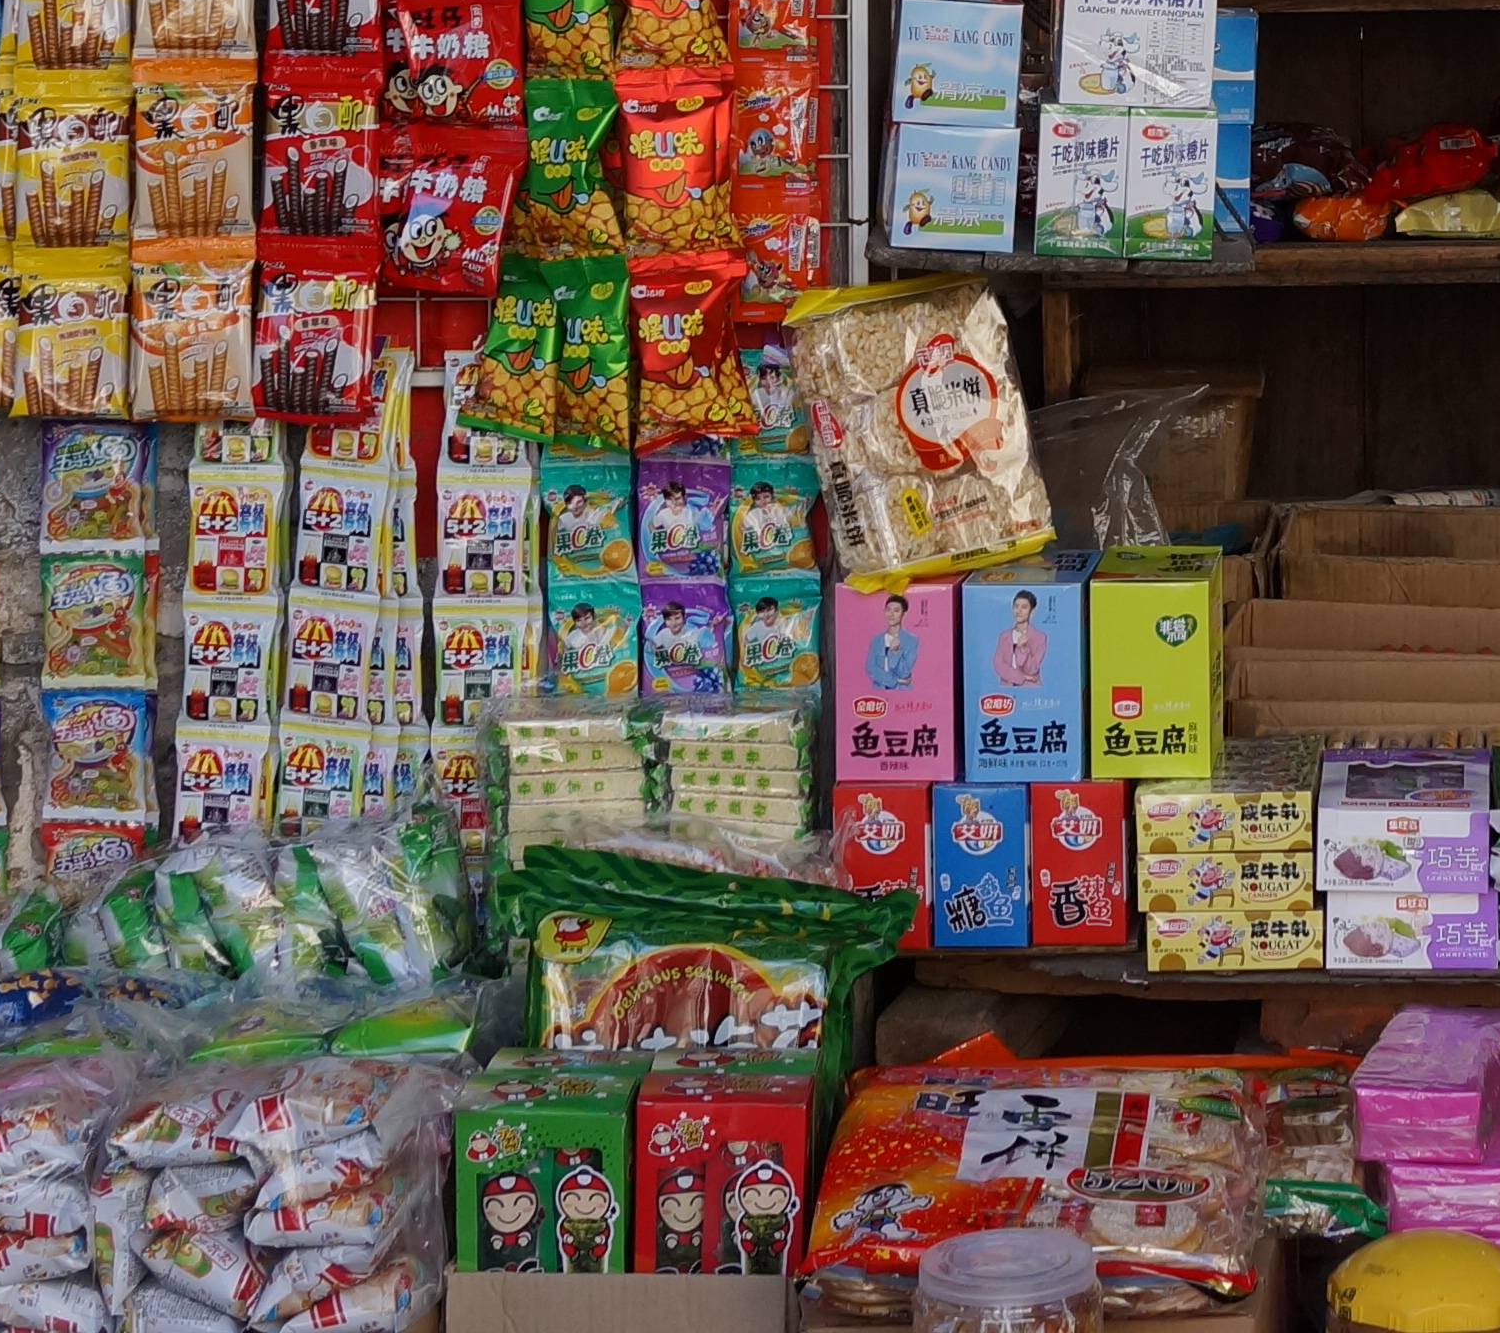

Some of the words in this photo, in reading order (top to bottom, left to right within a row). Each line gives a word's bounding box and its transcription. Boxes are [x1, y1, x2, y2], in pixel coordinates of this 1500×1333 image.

[1077, 5, 1117, 16] GANCHI
[952, 28, 980, 45] KANG
[982, 30, 1016, 47] CANDY
[1050, 138, 1121, 166] 干吃奶味糖片
[849, 722, 940, 757] 鱼豆腐
[977, 719, 1069, 757] 鱼豆腐
[1102, 723, 1189, 757] 鱼豆腐
[1240, 822, 1293, 835] NOUGAT
